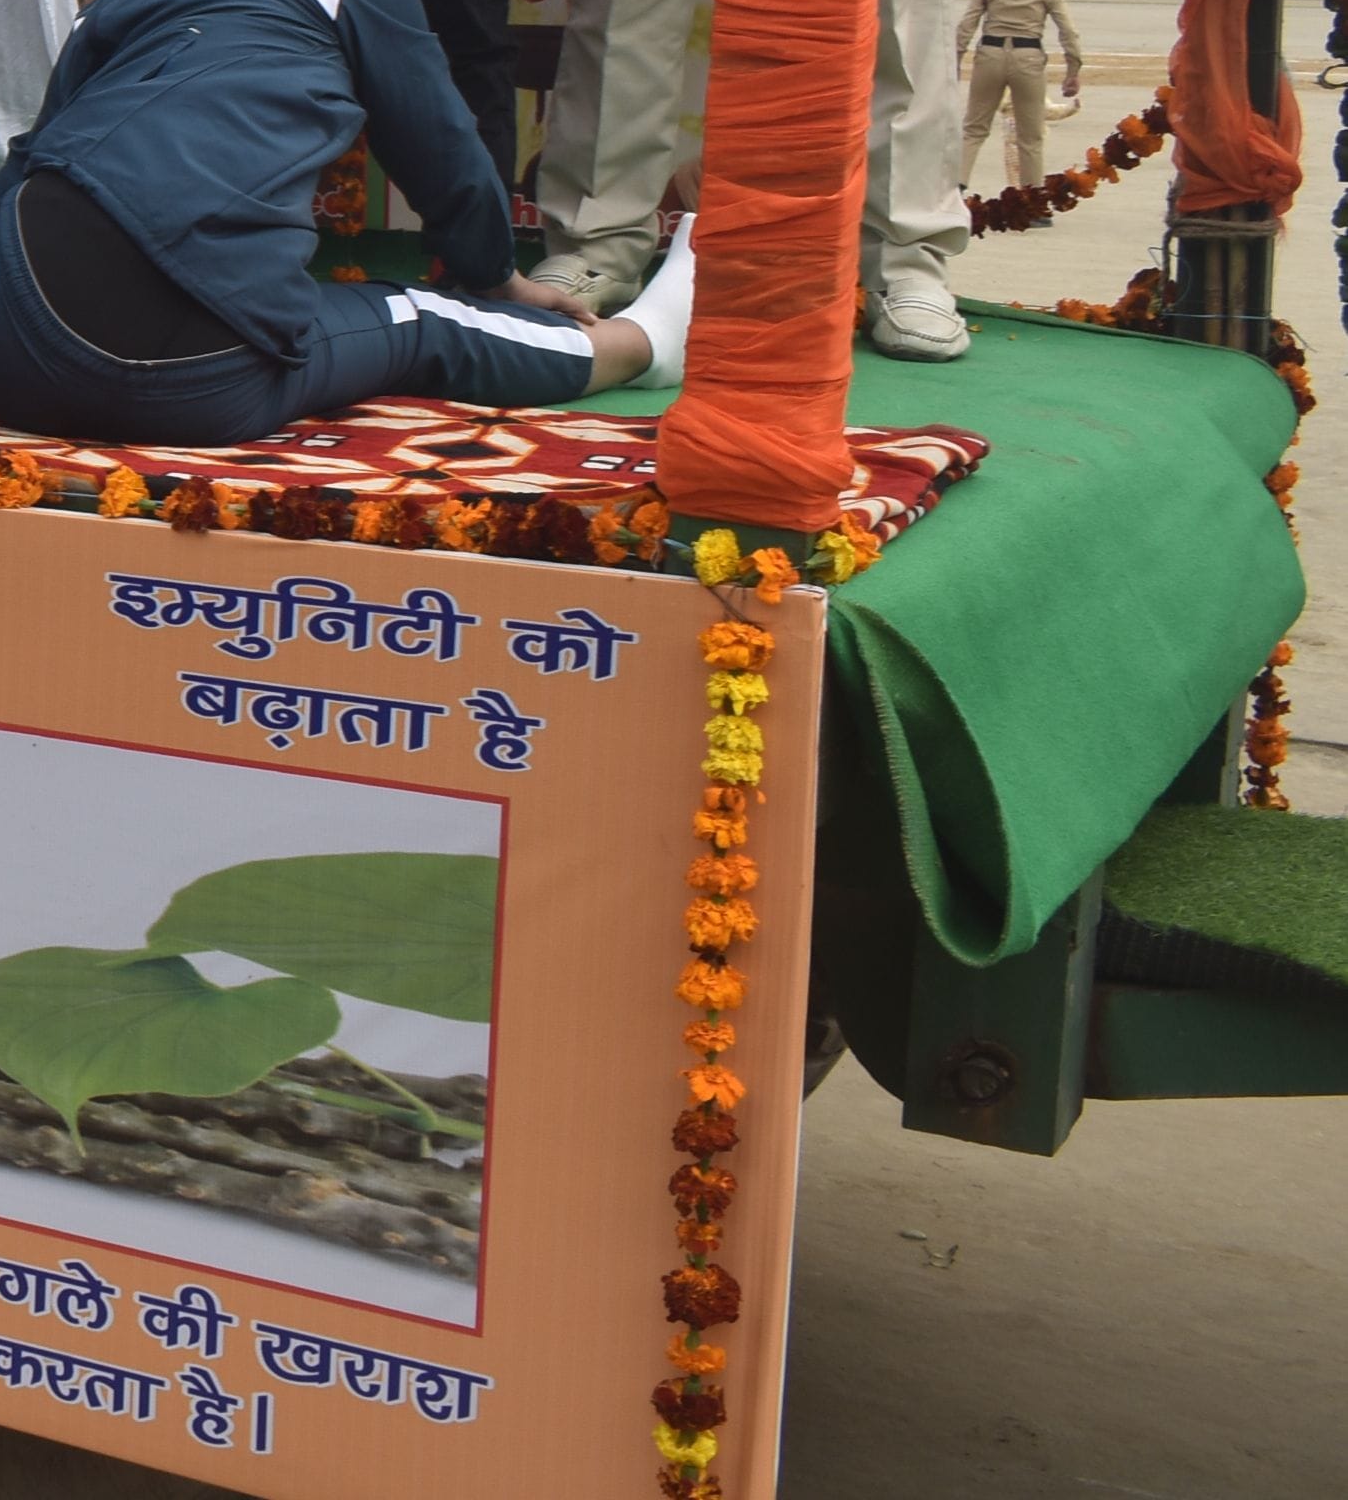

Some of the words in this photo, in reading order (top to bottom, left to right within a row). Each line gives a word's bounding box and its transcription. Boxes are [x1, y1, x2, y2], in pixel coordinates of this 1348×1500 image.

[105, 572, 479, 661] इम्युनिटी
[501, 607, 639, 682] को
[178, 671, 448, 752] बढ़ाता
[461, 688, 547, 772] है
[139, 1287, 236, 1361] की
[255, 1318, 492, 1424] खराश
